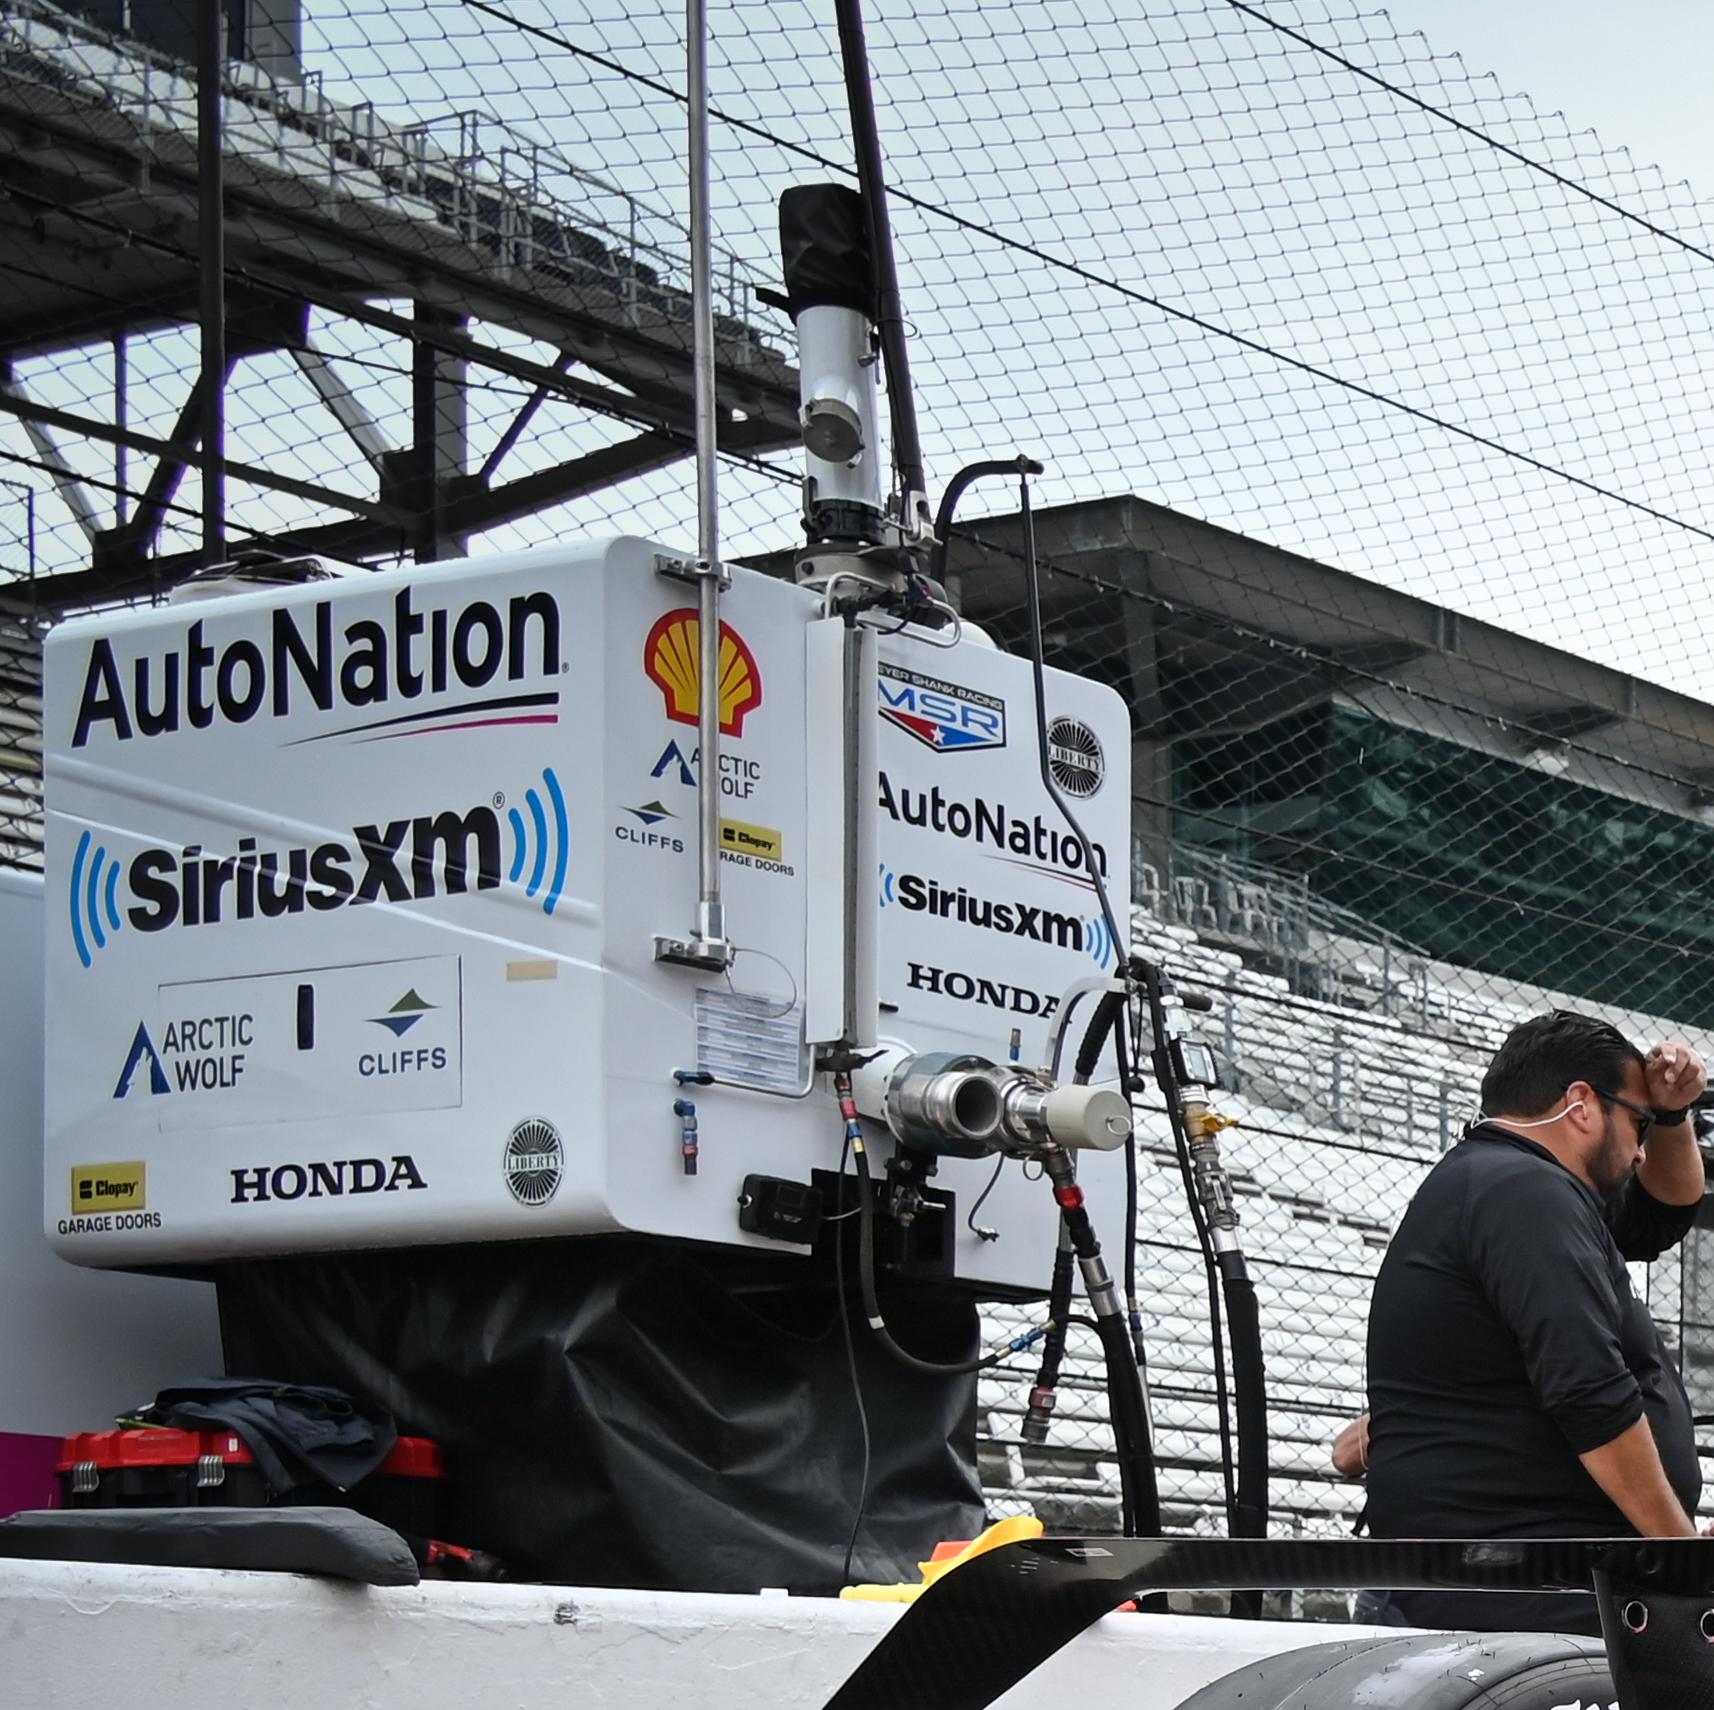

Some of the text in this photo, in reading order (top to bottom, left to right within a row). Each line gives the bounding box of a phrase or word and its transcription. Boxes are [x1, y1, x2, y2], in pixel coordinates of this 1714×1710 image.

[70, 585, 562, 748] AutoNation
[878, 663, 911, 683] EYER
[911, 673, 955, 697] SHANK
[690, 747, 761, 780] ACTIC
[1048, 744, 1101, 771] LIBERTY
[720, 776, 755, 800] OLF
[878, 770, 1109, 878] AutoNation
[614, 826, 685, 854] CLIFFS
[738, 831, 774, 851] Clopay
[720, 851, 795, 877] RAGE DOORS
[906, 962, 1060, 1021] HONDA
[163, 1014, 255, 1054] ARCTIC
[174, 1054, 246, 1093] WOLF
[358, 1046, 448, 1077] CLIFFS
[507, 1152, 561, 1172] LIBERTY
[94, 1178, 140, 1201] Clopay
[229, 1154, 429, 1204] HONDA
[57, 1212, 162, 1236] GARAGE DOORS
